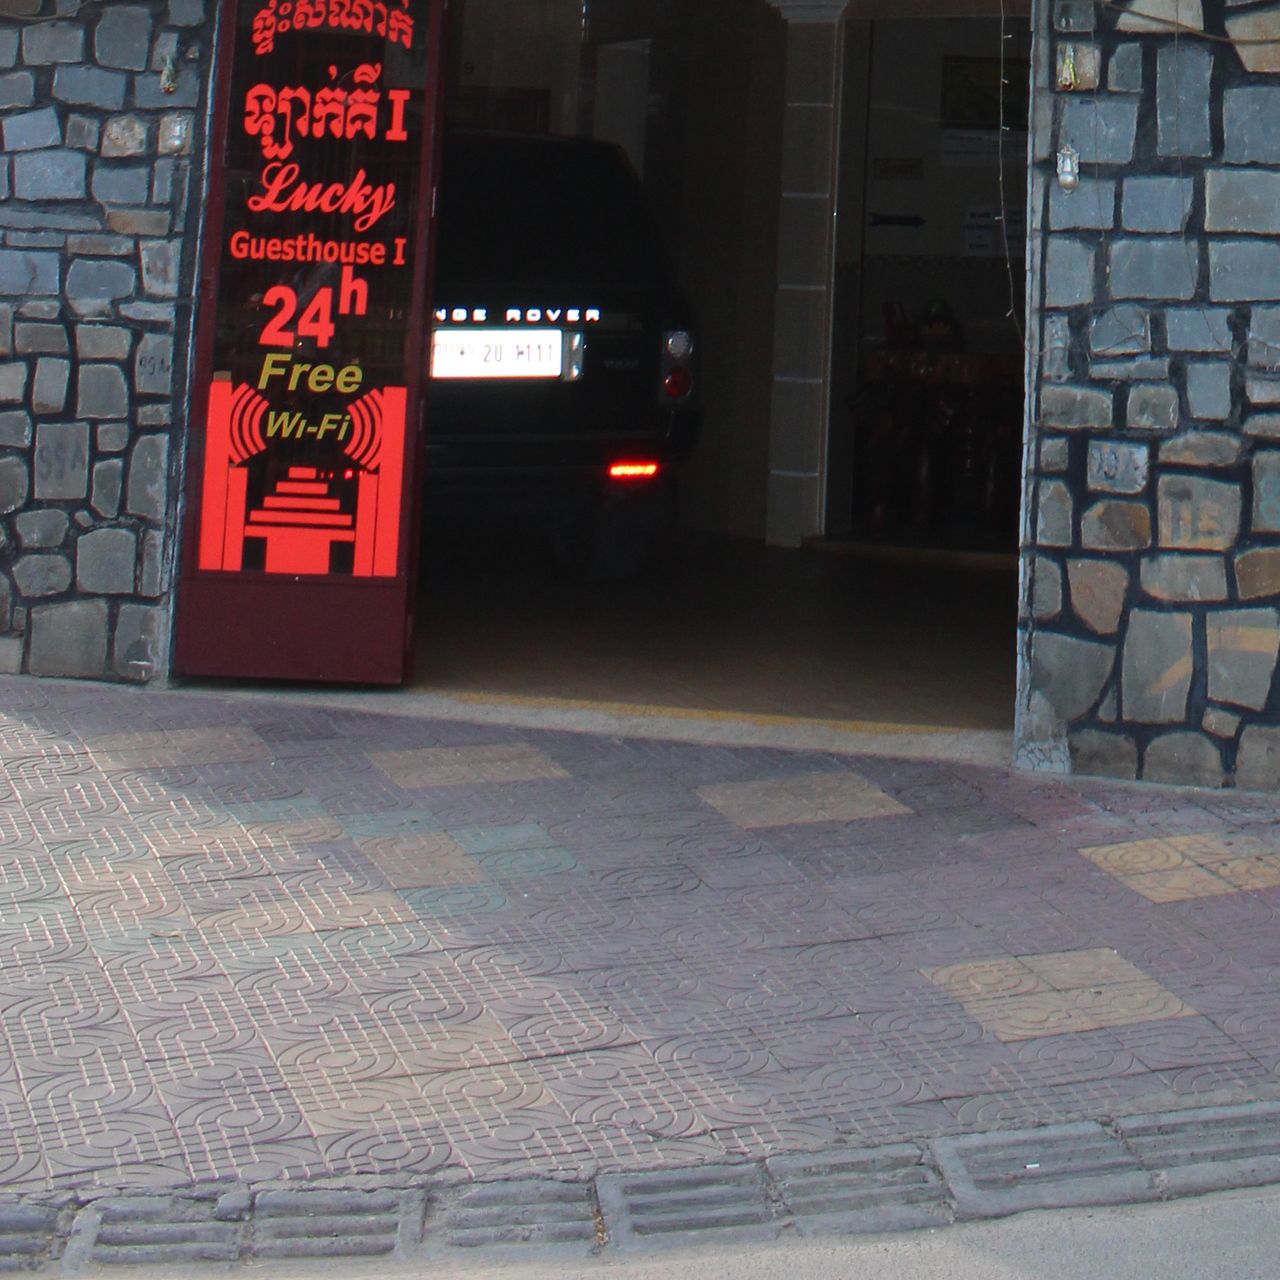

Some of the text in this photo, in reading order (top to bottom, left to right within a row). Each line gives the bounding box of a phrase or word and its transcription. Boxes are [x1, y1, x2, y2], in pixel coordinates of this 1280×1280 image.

[247, 162, 396, 232] Lucky
[229, 230, 386, 265] Guesthouse
[506, 308, 600, 322] ROVER
[257, 352, 363, 394] Free
[266, 410, 351, 441] Wi-Fi
